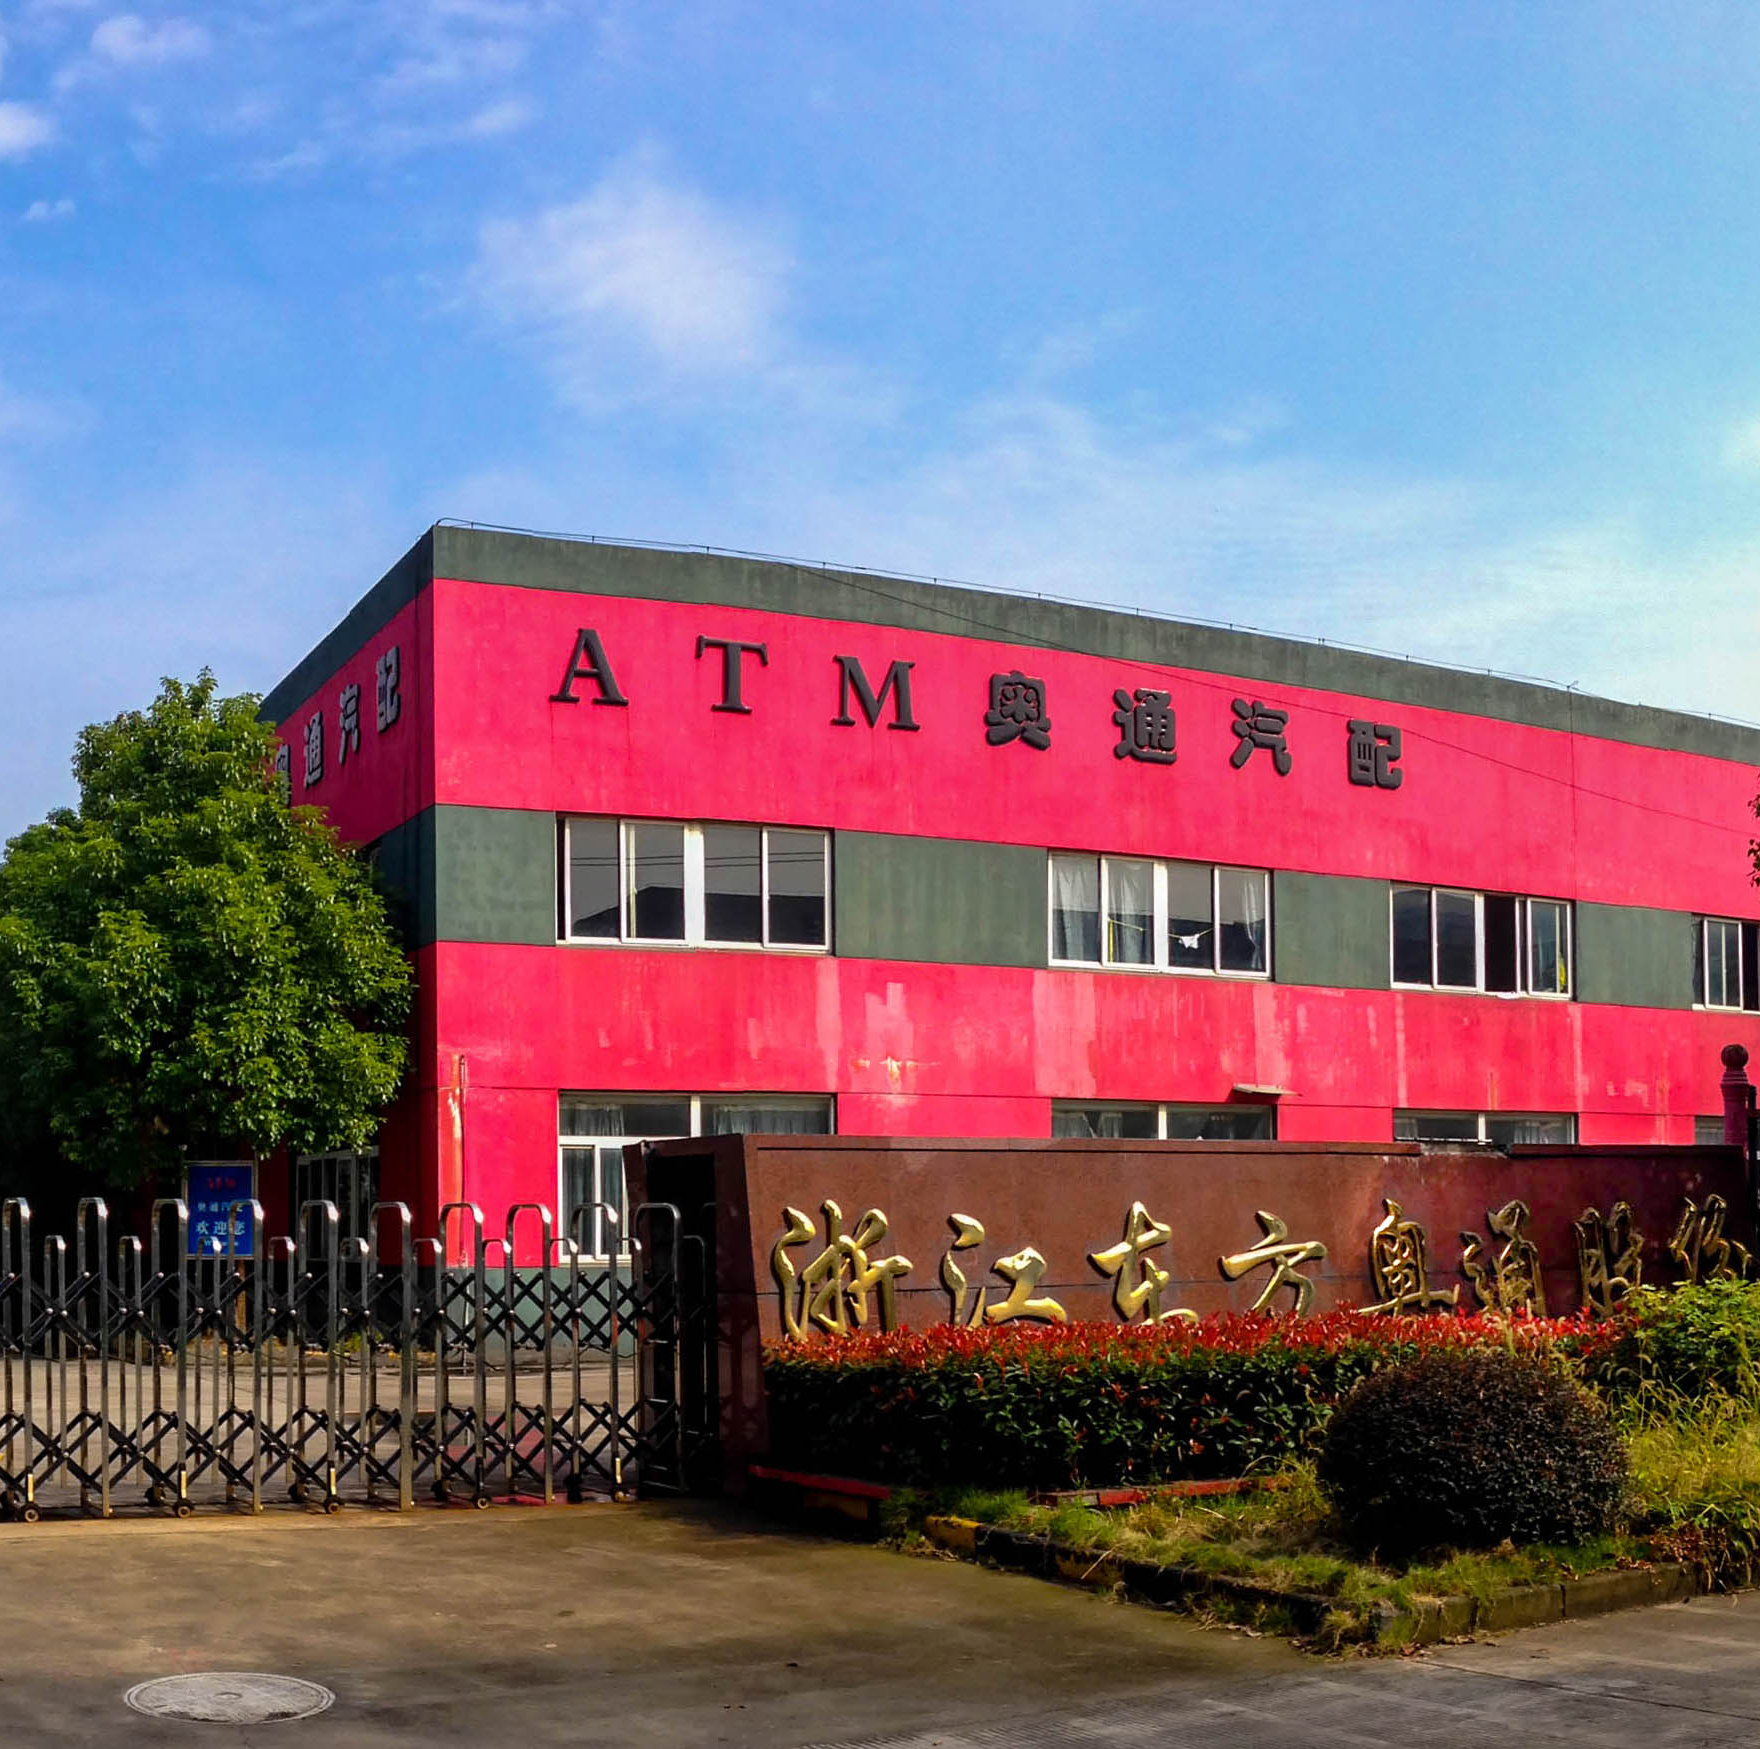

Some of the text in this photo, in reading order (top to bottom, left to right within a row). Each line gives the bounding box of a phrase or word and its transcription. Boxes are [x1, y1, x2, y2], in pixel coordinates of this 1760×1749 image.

[549, 628, 920, 731] ATM
[986, 670, 1403, 790] 奥通汽配
